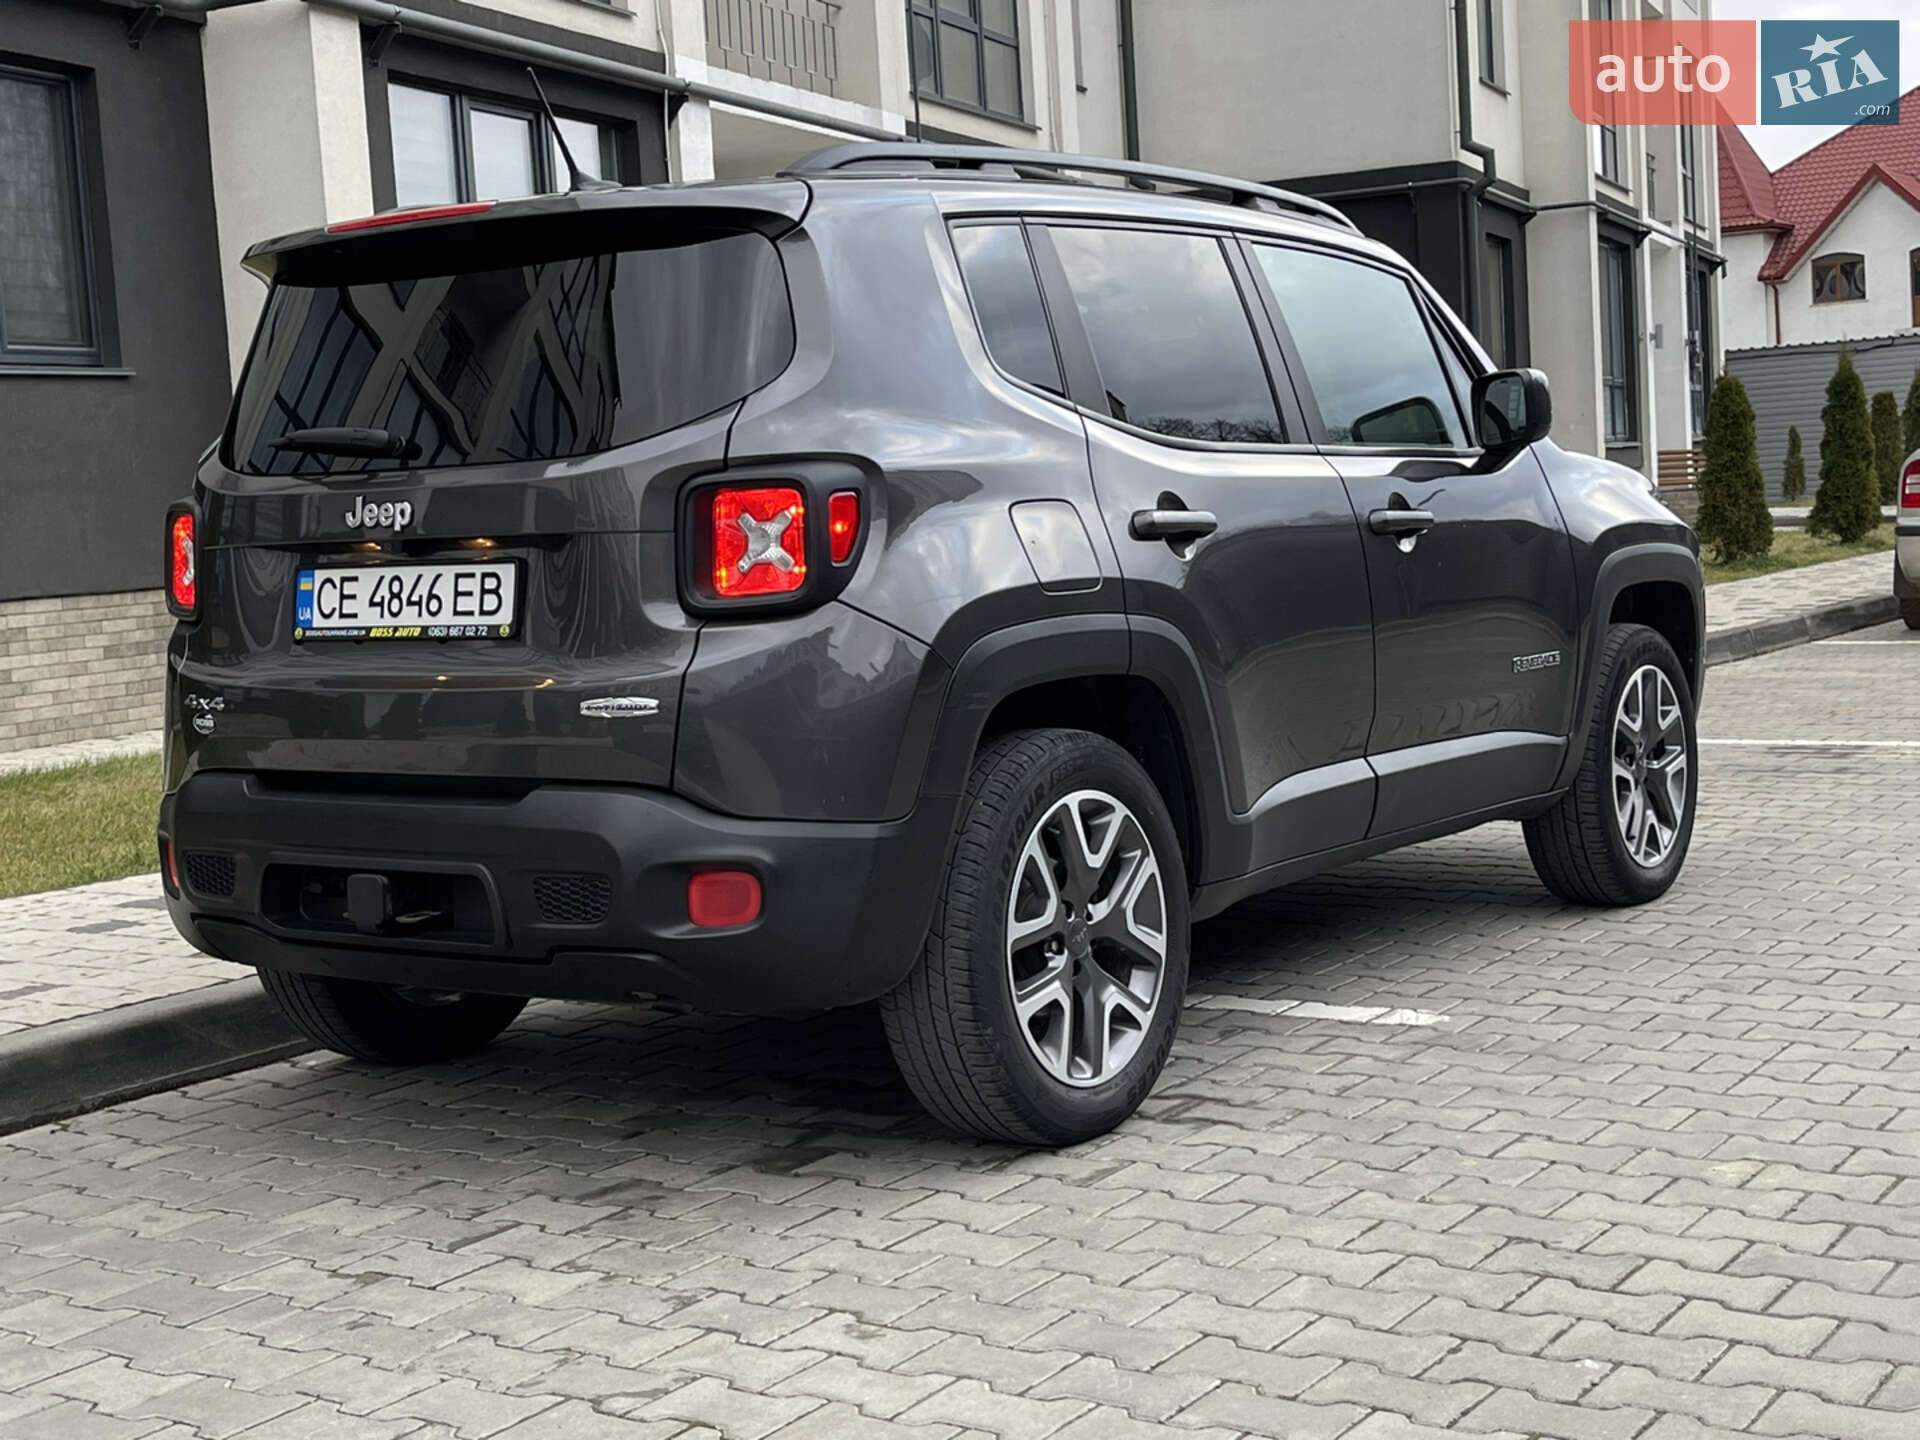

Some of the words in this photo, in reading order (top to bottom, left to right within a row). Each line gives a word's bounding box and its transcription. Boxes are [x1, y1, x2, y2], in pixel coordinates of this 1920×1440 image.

[345, 496, 413, 531] Jeep
[316, 576, 359, 620] CE
[368, 572, 444, 619] 4846
[452, 571, 503, 617] EB
[298, 608, 312, 621] UA
